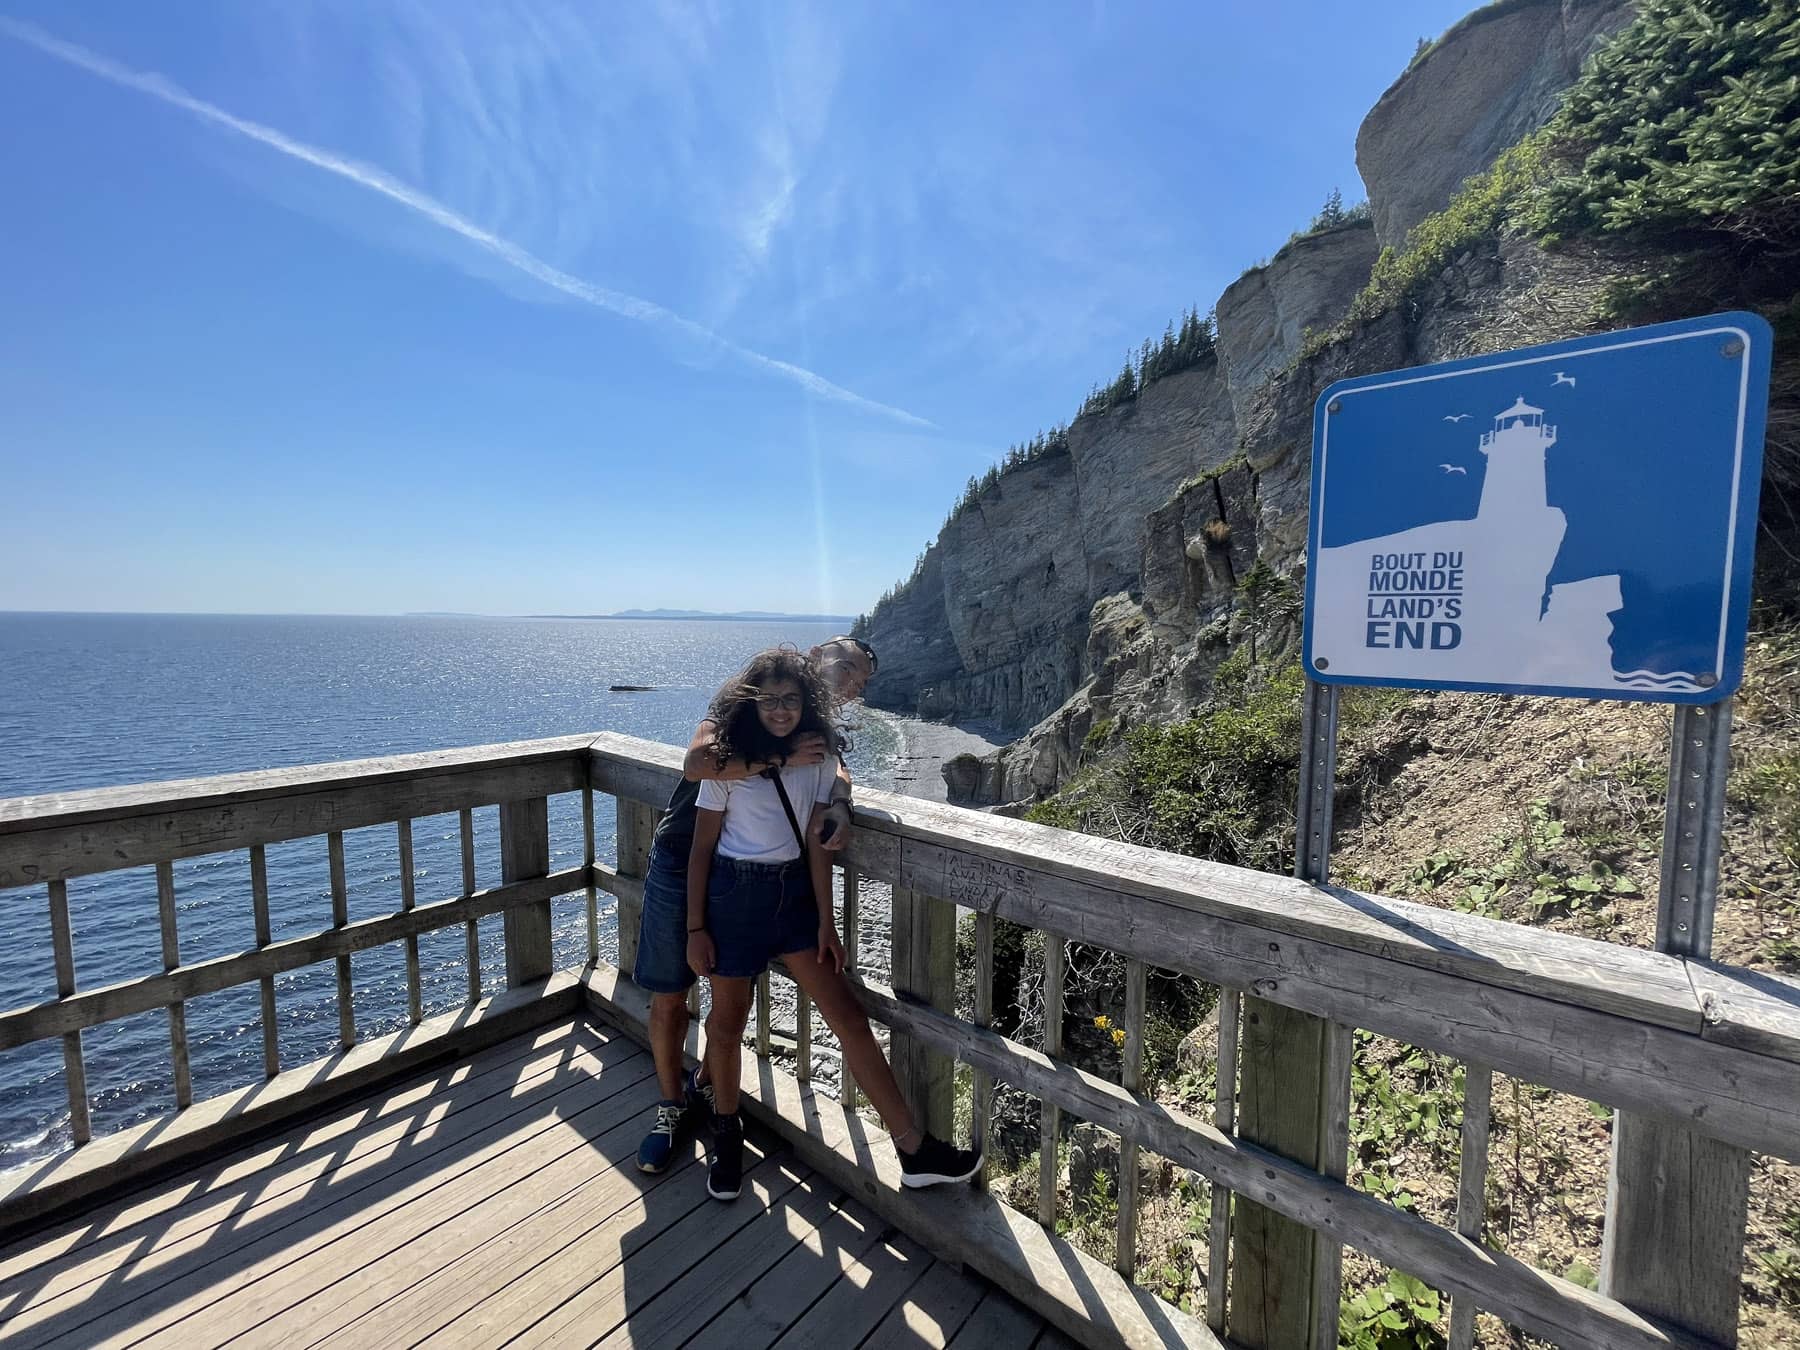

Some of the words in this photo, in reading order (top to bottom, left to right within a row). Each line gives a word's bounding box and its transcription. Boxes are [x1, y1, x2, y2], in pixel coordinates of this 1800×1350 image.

[1371, 553, 1427, 570] BOUT
[1433, 552, 1463, 569] DU
[1369, 570, 1463, 591] MONDE
[1367, 598, 1462, 619] LAND'S
[1366, 621, 1462, 649] END
